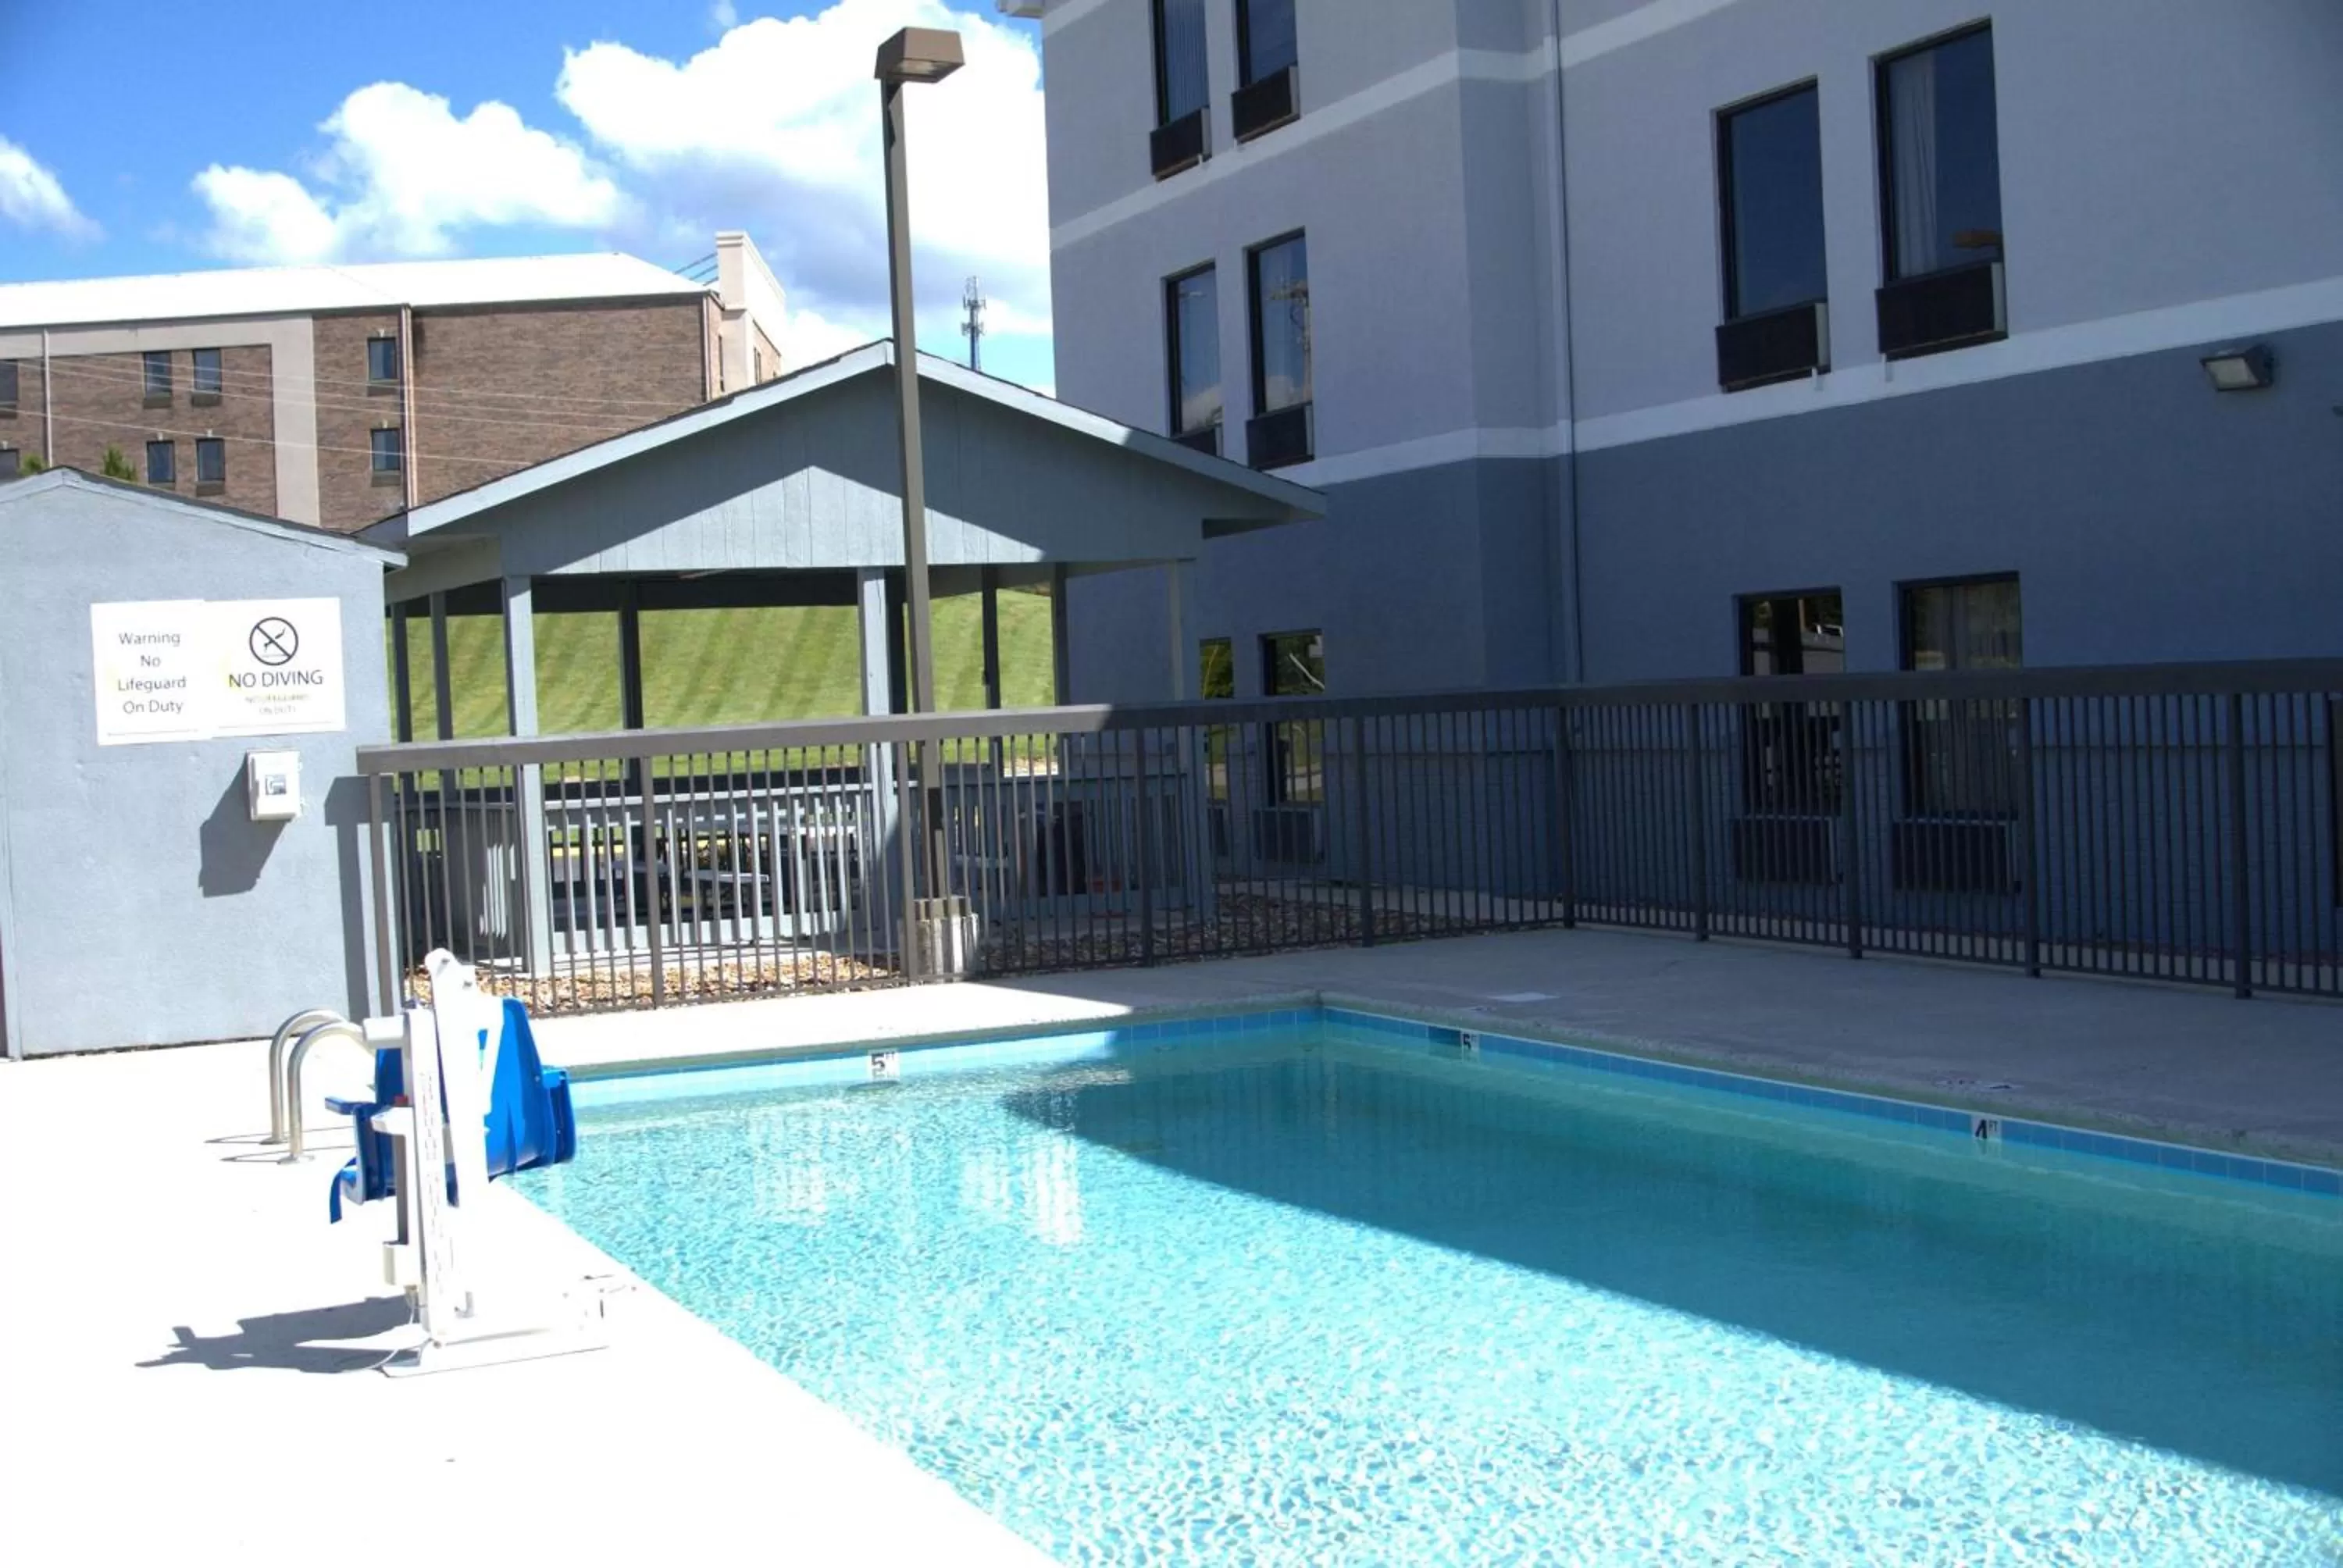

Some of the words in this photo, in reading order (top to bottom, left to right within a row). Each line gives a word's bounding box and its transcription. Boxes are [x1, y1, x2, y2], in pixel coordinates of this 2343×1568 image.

[118, 631, 181, 647] Warning
[141, 654, 162, 667] No
[118, 675, 187, 693] Lifeguard
[229, 672, 256, 688] NO
[262, 669, 323, 687] DIVING
[123, 700, 144, 714] On
[149, 699, 184, 714] Duty
[871, 1053, 886, 1071] 5
